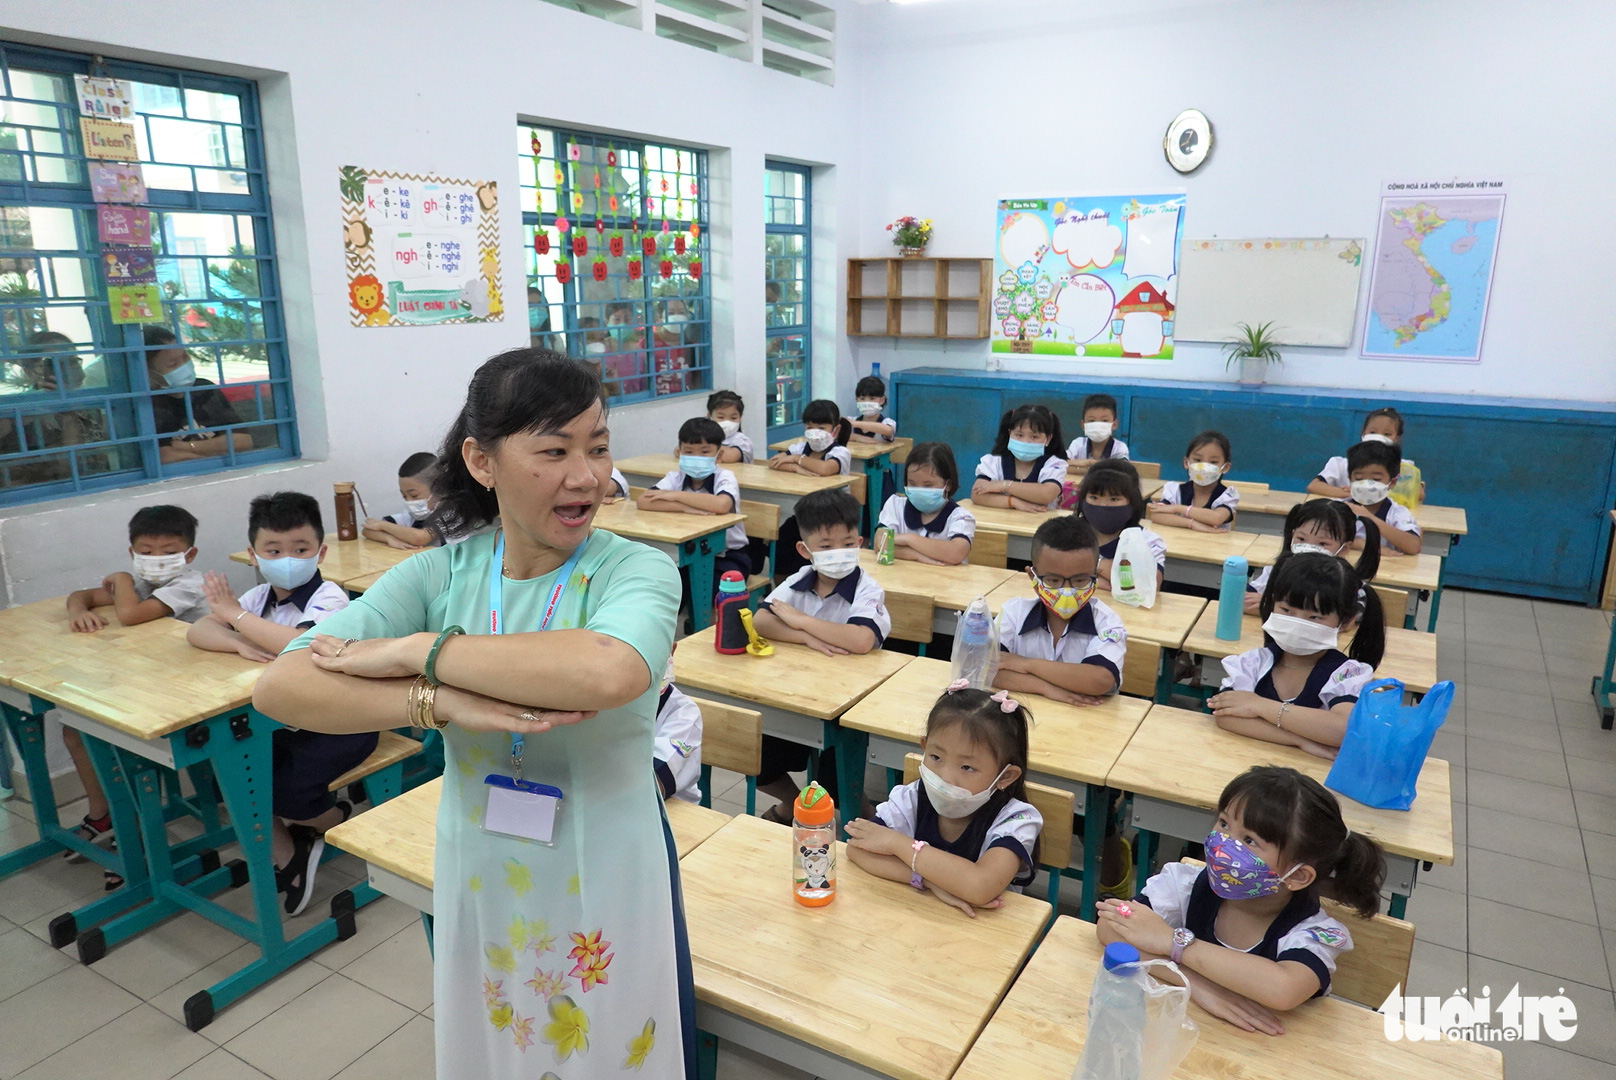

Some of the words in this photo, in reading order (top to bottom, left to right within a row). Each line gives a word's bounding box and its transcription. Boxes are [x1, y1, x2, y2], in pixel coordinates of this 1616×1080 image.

[82, 84, 124, 98] Class
[85, 99, 131, 116] Rules
[398, 186, 409, 196] ke
[368, 194, 376, 208] k
[460, 193, 474, 204] ghe
[424, 198, 438, 214] gh
[401, 210, 408, 220] ki
[460, 214, 472, 224] ghi
[108, 224, 130, 234] hand
[440, 241, 460, 252] nghe
[396, 248, 418, 264] ngh
[442, 262, 459, 273] nghi
